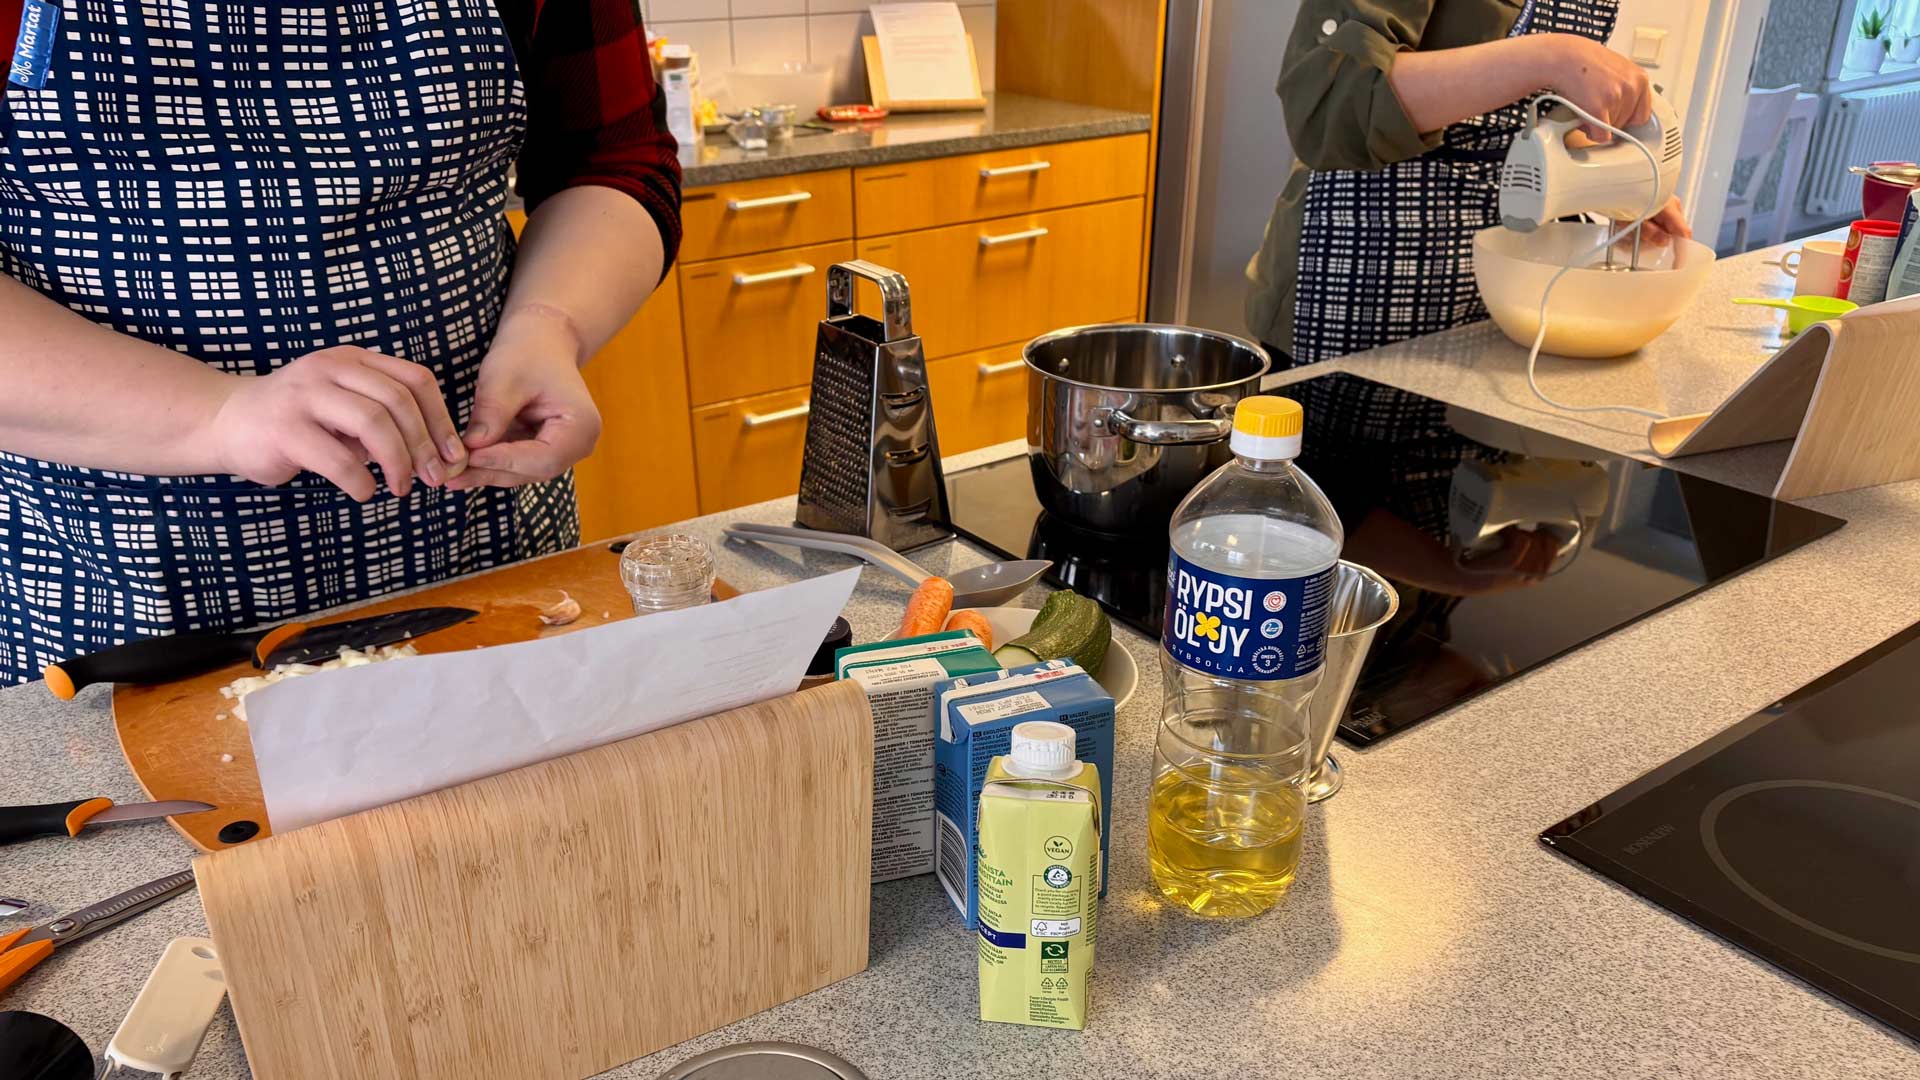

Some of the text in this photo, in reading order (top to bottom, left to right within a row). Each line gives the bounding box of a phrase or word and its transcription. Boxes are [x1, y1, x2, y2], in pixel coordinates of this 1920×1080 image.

[18, 4, 42, 59] Martat
[1177, 569, 1254, 621] RYPSI
[1174, 601, 1250, 657] ÖLJY
[1171, 645, 1245, 673] RYBSOLJA
